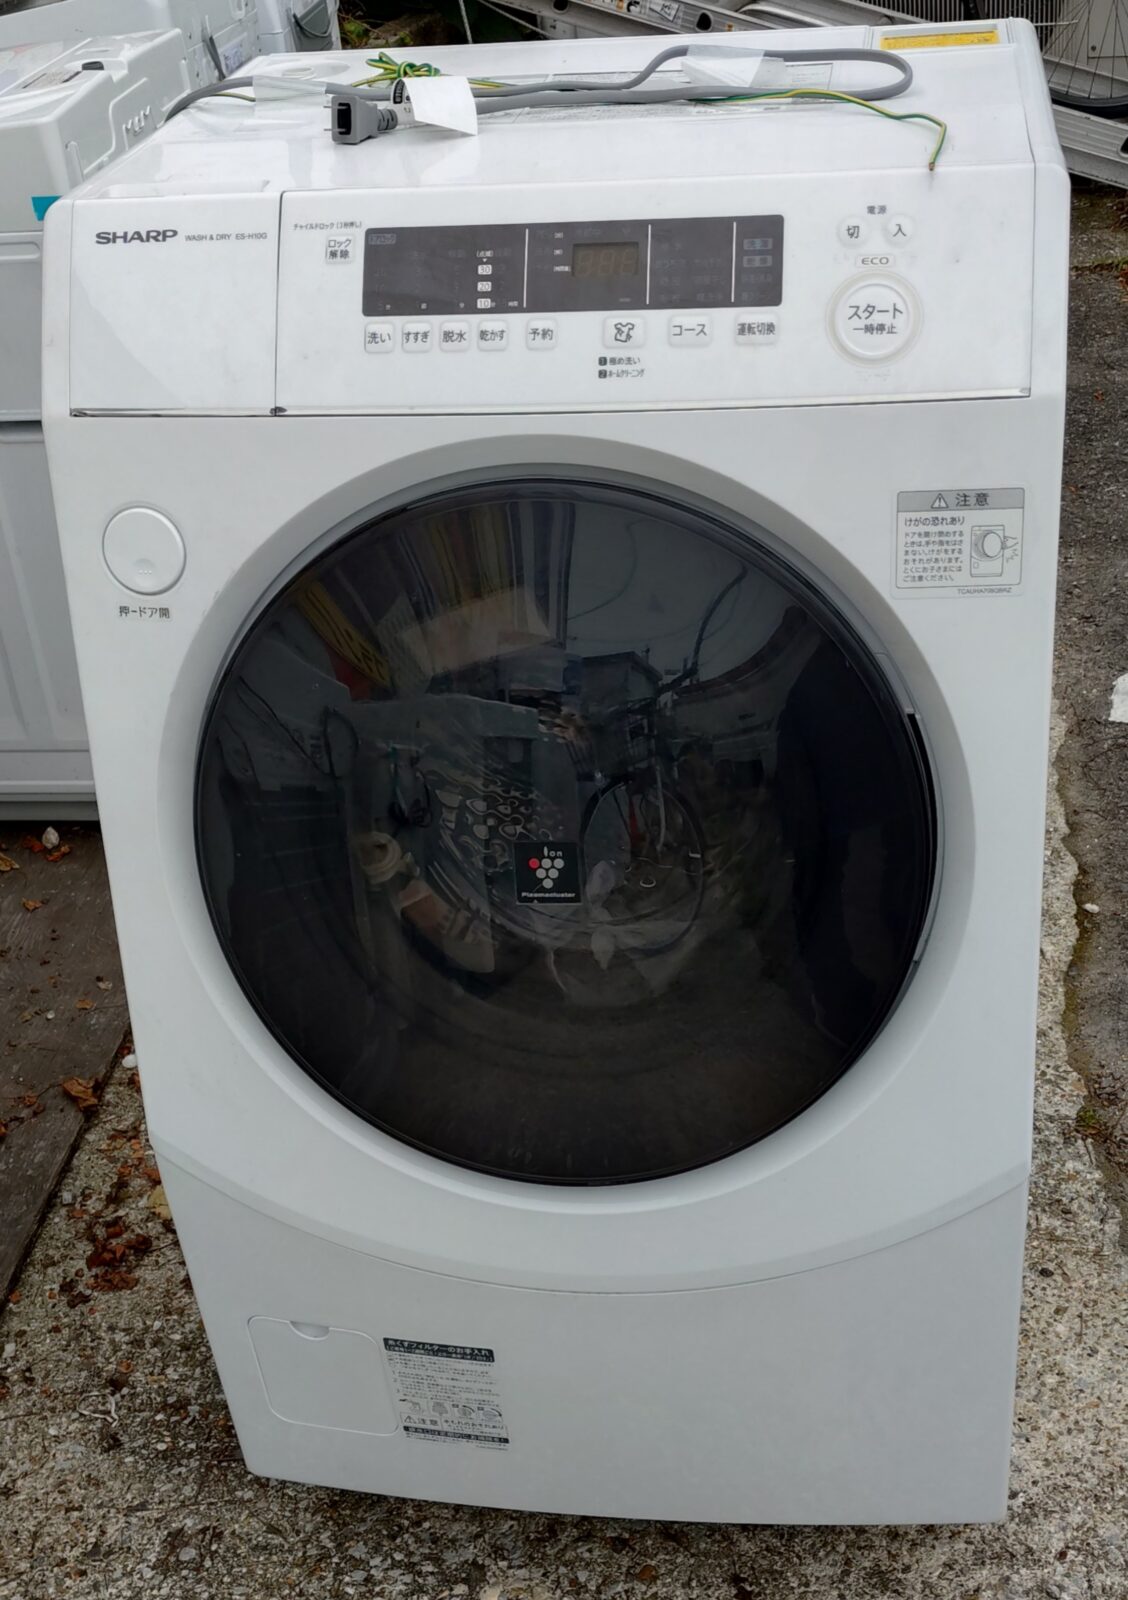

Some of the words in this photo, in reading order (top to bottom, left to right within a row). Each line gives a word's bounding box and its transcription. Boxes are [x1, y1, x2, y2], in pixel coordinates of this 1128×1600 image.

[867, 204, 887, 215] 電源
[95, 229, 178, 245] SHARP
[185, 234, 208, 242] WASH
[216, 233, 232, 241] DRY
[235, 232, 268, 241] ES-H10G
[846, 224, 860, 239] 切
[893, 224, 907, 237] 入
[327, 238, 352, 249] ロック
[328, 249, 350, 260] 解除
[861, 256, 889, 265] ECO
[479, 265, 491, 274] 30
[478, 282, 490, 291] 20
[478, 299, 490, 308] 10
[847, 302, 904, 320] スタート
[479, 329, 506, 342] 乾かす
[528, 327, 554, 341] 予約
[672, 323, 708, 337] コース
[736, 323, 776, 337] 運転切換
[852, 323, 897, 335] 一時停止
[367, 331, 392, 344] 洗い
[403, 331, 430, 344] すすぎ
[442, 330, 467, 343] 脱水
[955, 492, 990, 507] 注意
[904, 515, 966, 527] けがの恐れあり
